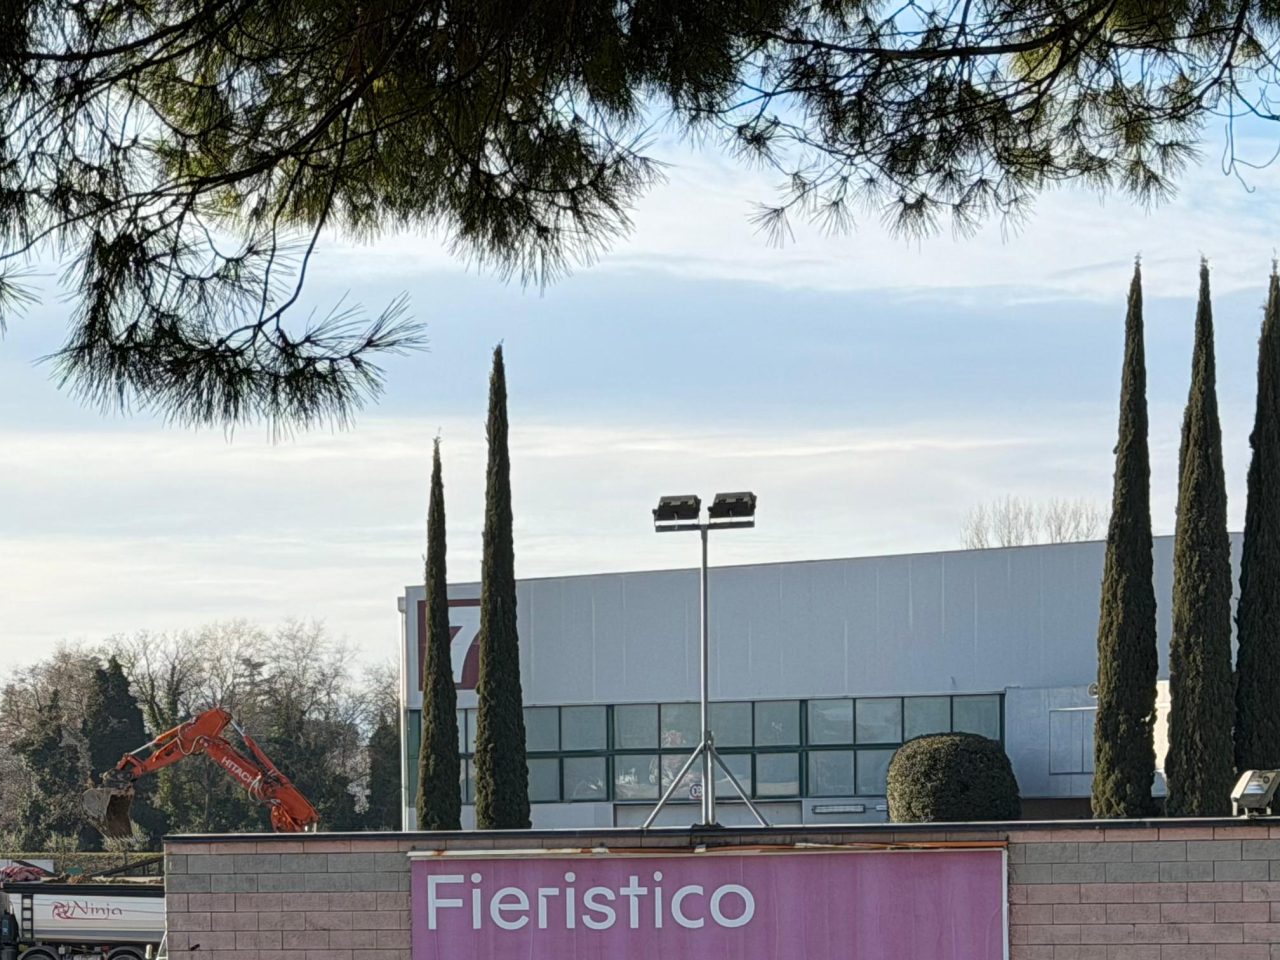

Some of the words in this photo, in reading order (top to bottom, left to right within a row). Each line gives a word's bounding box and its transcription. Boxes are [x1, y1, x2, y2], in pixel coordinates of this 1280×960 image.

[448, 606, 481, 683] 7
[70, 900, 122, 919] Ninja
[427, 871, 755, 930] Fieristico
